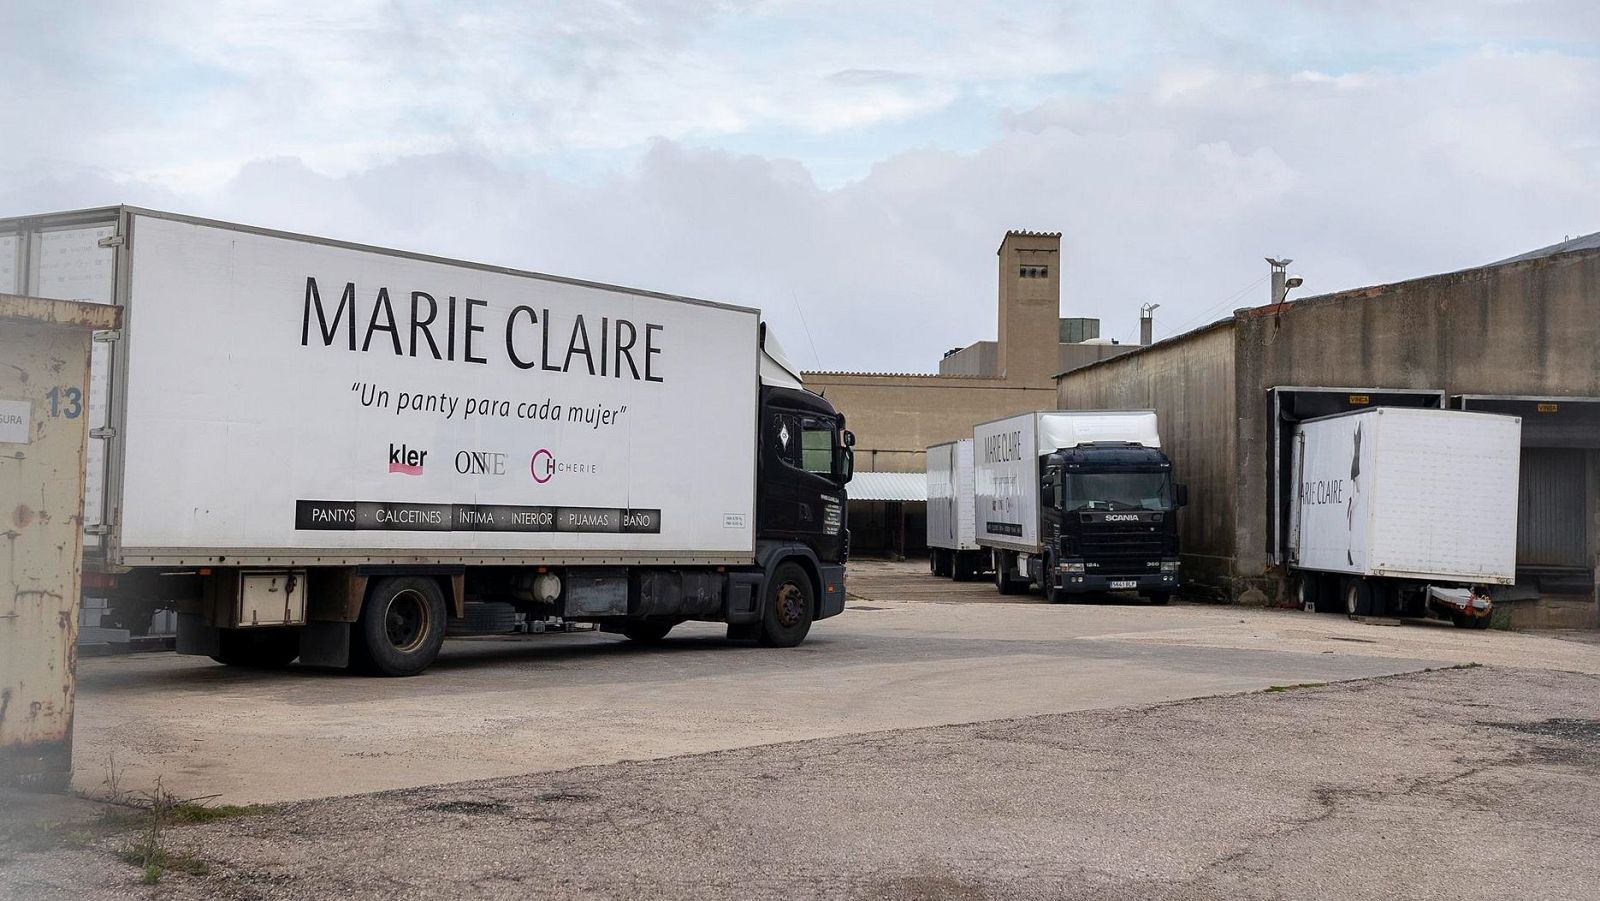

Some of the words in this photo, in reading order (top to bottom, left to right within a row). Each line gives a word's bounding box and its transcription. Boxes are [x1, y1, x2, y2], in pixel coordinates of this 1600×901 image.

[300, 276, 488, 365] MARIE
[505, 304, 664, 383] CLAIRE
[46, 386, 82, 419] 13
[396, 391, 459, 420] panty
[464, 396, 510, 420] para
[517, 398, 562, 421] cada
[388, 443, 428, 467] kler
[984, 434, 1002, 464] MARIE
[1002, 430, 1022, 462] CLAIRE
[558, 462, 597, 474] CHERIE
[1300, 481, 1316, 505] ARIE
[1317, 479, 1343, 505] CLAIRE
[312, 508, 356, 523] PANTYS
[375, 509, 442, 524] CALCETINES
[459, 508, 495, 525] ÍNTIMA
[511, 512, 553, 526] INTERIOR
[569, 513, 609, 527] PIJAMAS
[623, 513, 651, 528] BAÑO
[1105, 514, 1139, 522] SCANIA
